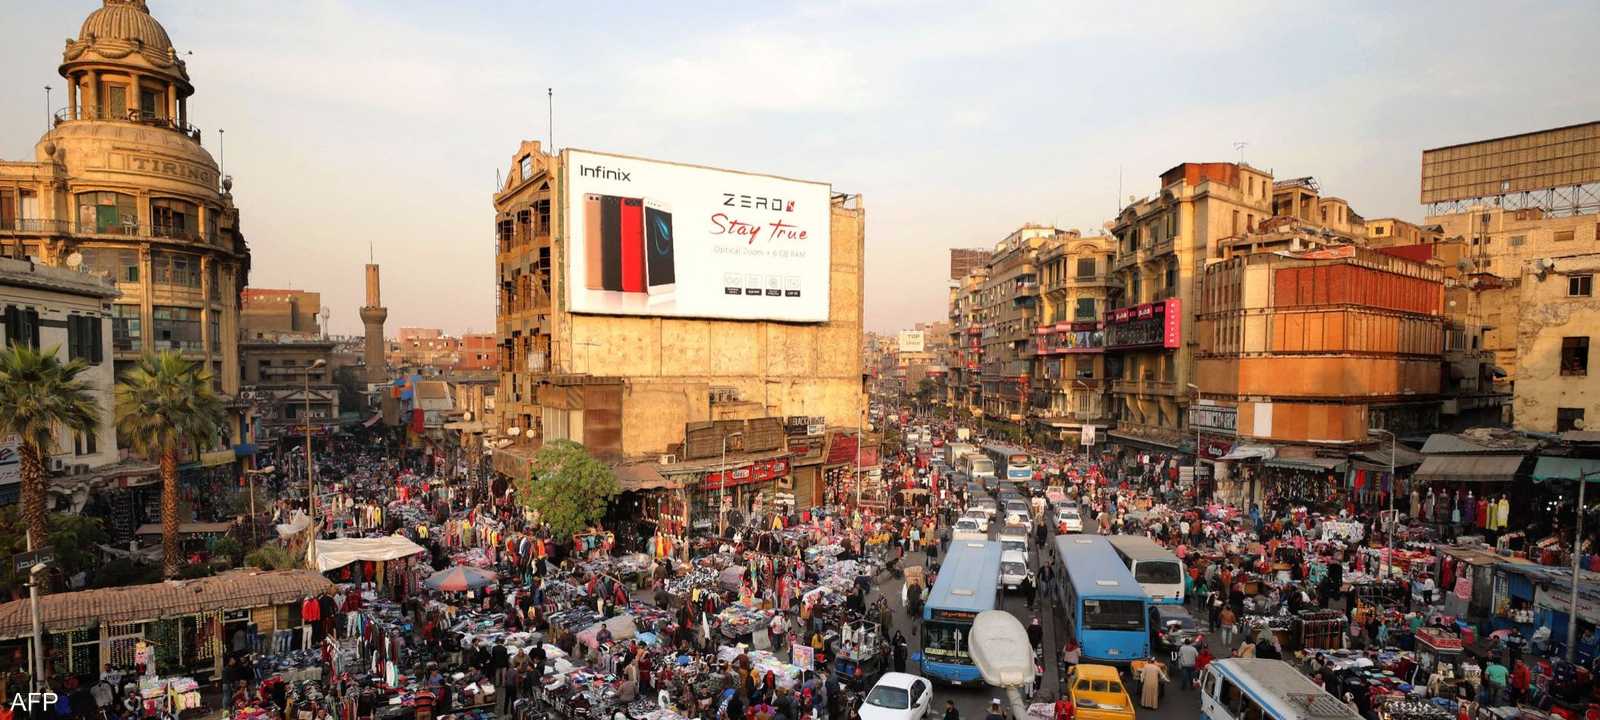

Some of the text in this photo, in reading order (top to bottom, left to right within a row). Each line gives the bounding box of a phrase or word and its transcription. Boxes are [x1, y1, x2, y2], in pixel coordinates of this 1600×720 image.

[133, 157, 209, 182] TIRING
[580, 164, 631, 182] Infinix
[723, 193, 782, 211] ZERO
[709, 213, 808, 245] Stay True
